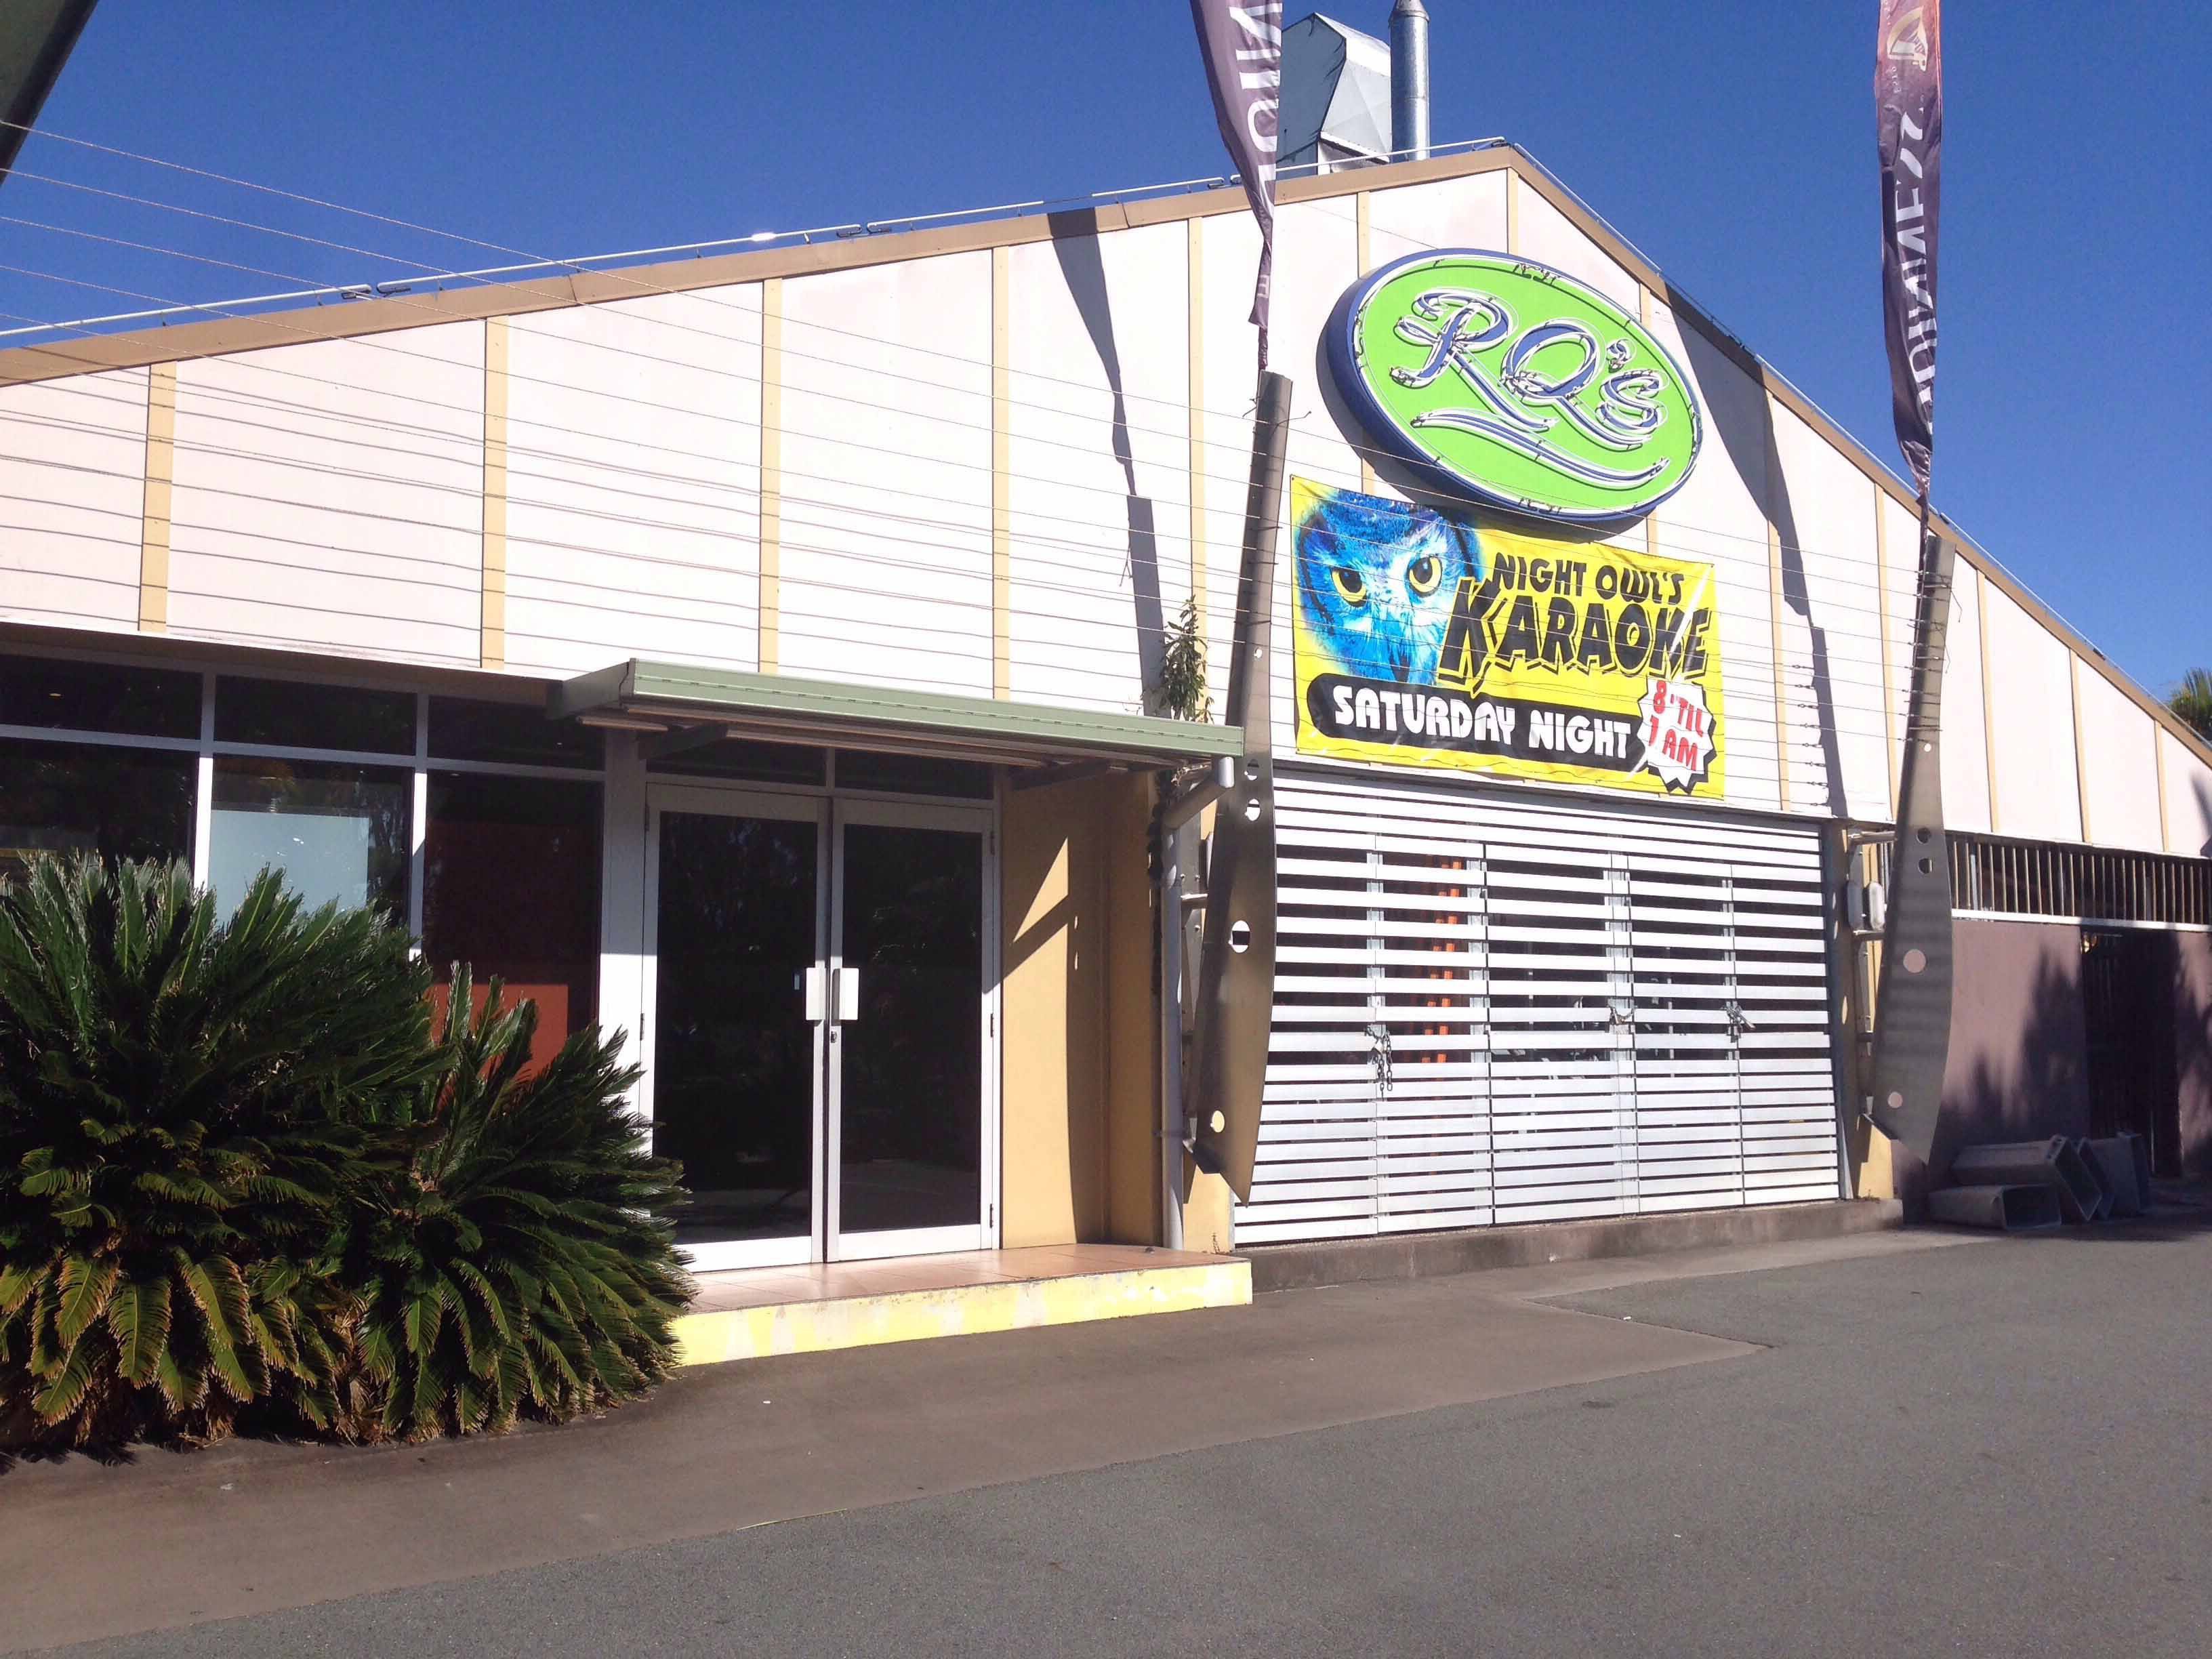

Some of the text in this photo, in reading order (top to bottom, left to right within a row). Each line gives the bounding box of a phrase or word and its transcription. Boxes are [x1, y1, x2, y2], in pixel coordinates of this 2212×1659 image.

[1492, 552, 1684, 605] NIGHT OWL'S
[1437, 577, 1711, 683] KARAOKE
[1332, 684, 1632, 759] SATURDAY NIGHT
[1653, 679, 1667, 715] 8
[1648, 714, 1698, 771] 1 AM
